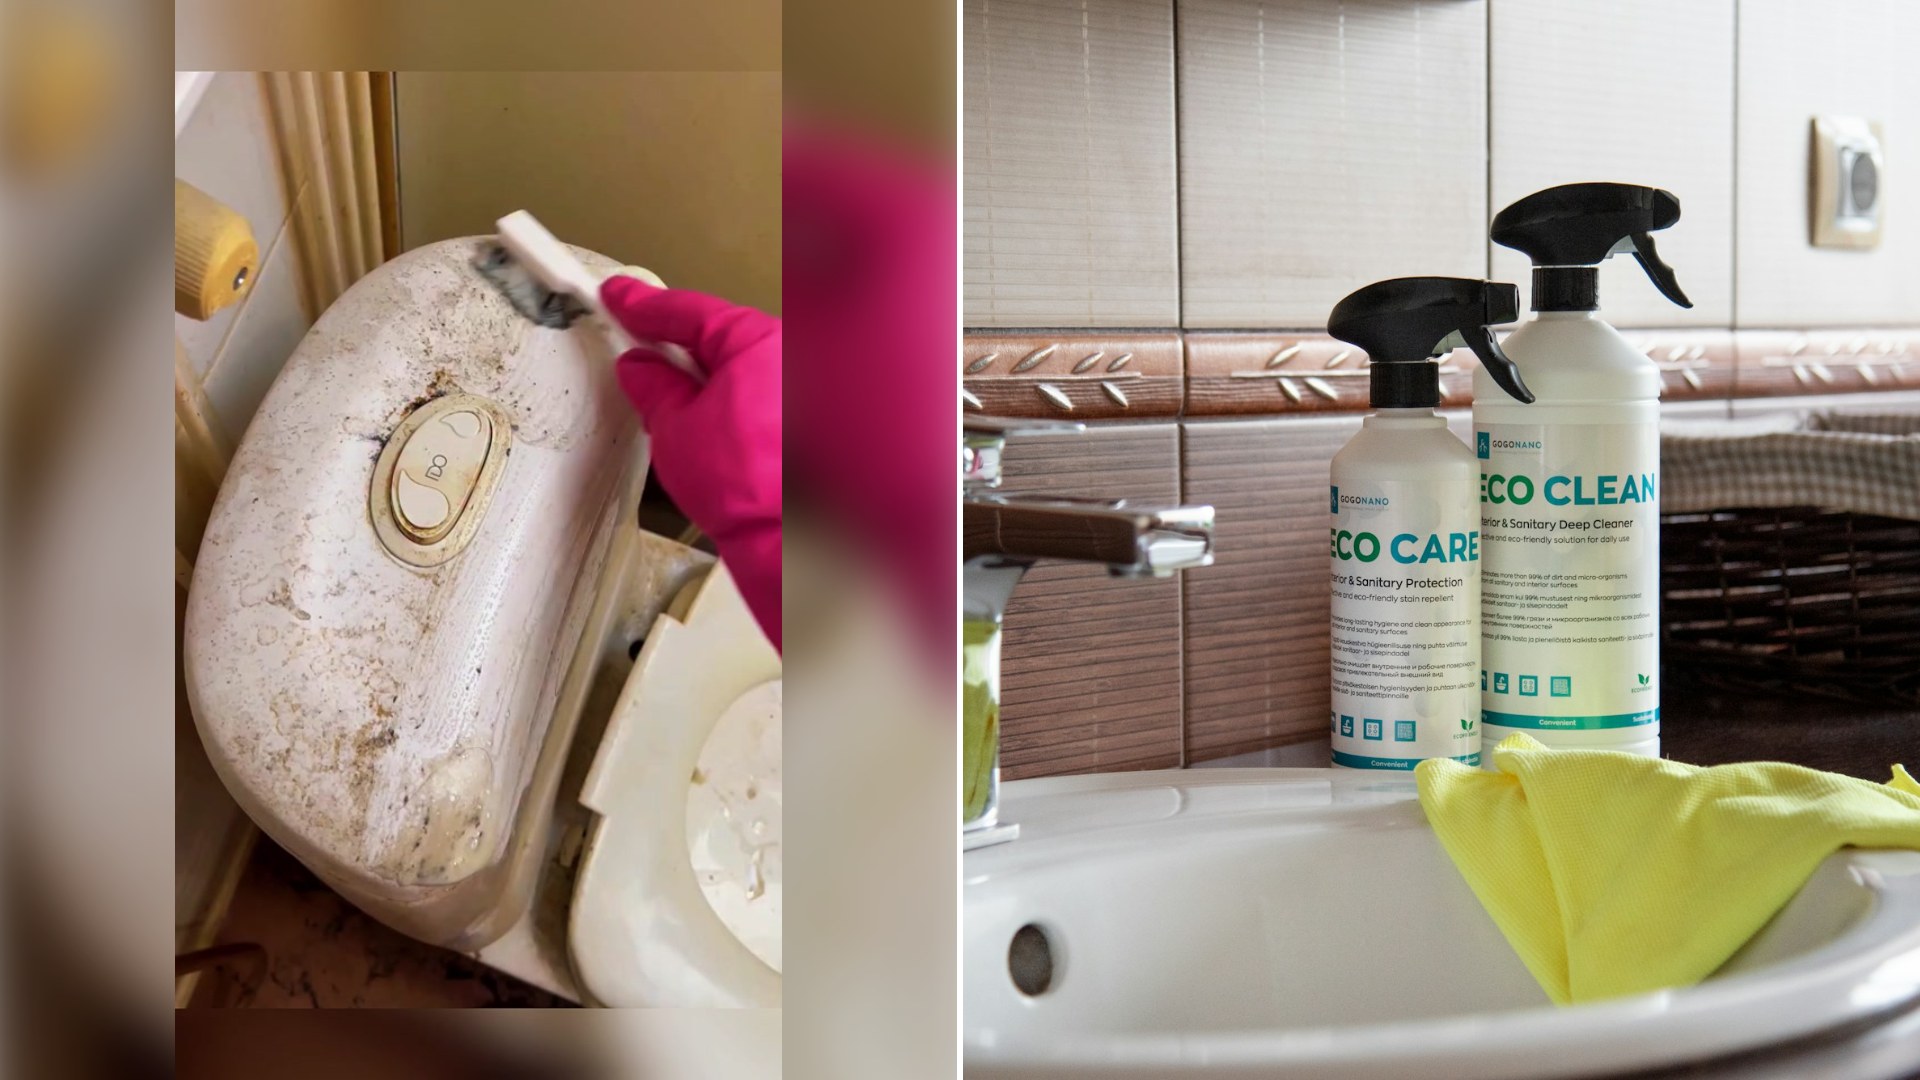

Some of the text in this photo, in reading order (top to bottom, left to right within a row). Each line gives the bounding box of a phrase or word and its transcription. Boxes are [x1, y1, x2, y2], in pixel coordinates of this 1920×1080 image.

[1492, 440, 1542, 449] GOGONANO
[1481, 473, 1655, 506] ECO CLEAN
[1340, 495, 1389, 506] GOGONANO
[1481, 516, 1634, 532] terior & Sanitary Deep Cleaner
[1508, 536, 1552, 544] eco-friendly
[1554, 536, 1586, 544] solution
[1587, 536, 1598, 544] for
[1600, 535, 1618, 544] daily
[1330, 528, 1479, 564] ECO CARE
[1331, 572, 1463, 590] terior & Sanitary Protection
[1354, 594, 1398, 604] eco-friendly
[1422, 594, 1454, 603] repellent
[1344, 618, 1374, 627] long-lasting
[1433, 620, 1465, 628] appearance
[1538, 718, 1577, 726] Convenient
[1370, 760, 1409, 768] Convenient
